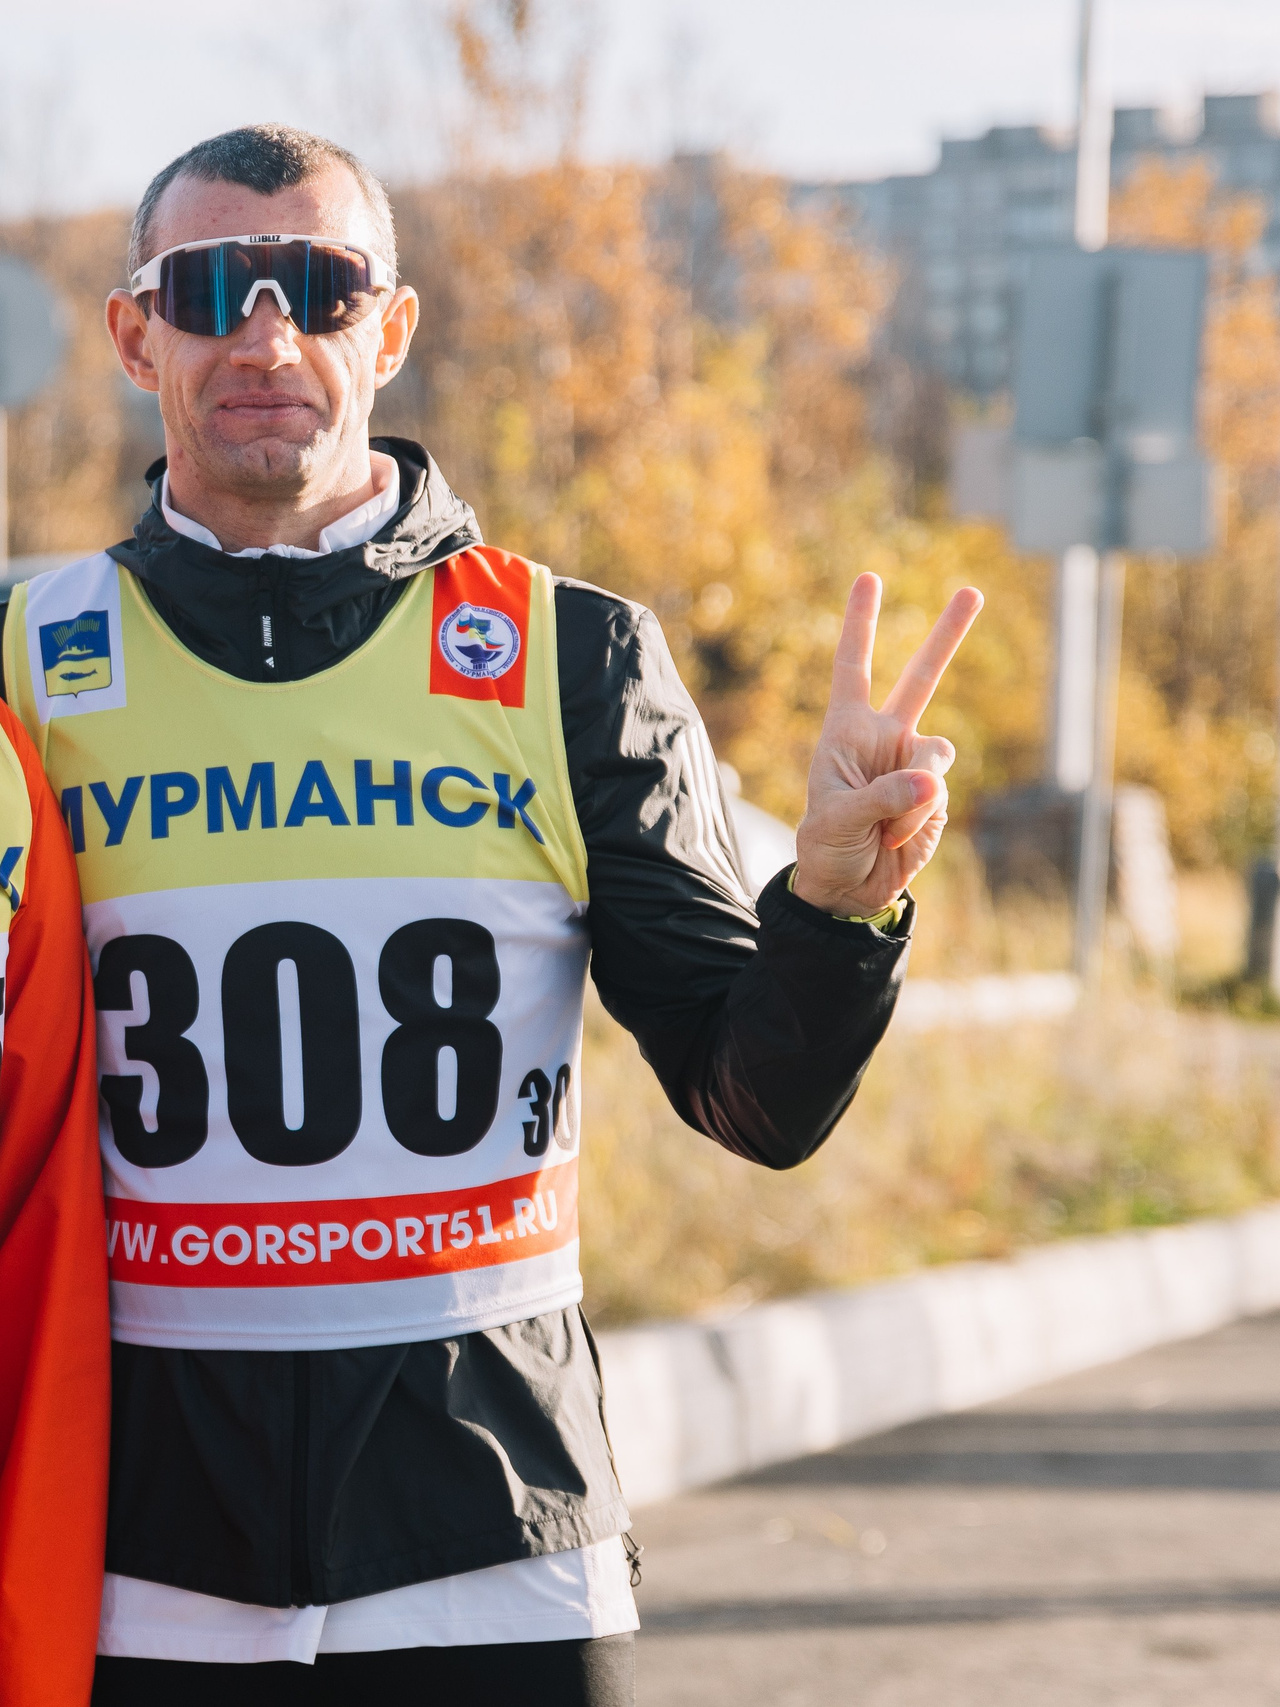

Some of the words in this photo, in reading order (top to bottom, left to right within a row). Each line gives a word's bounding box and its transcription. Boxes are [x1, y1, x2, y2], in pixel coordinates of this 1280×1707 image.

[261, 235, 282, 243] BLIZ
[262, 615, 273, 648] RUNNING
[94, 917, 503, 1168] 308
[517, 1062, 578, 1158] 30
